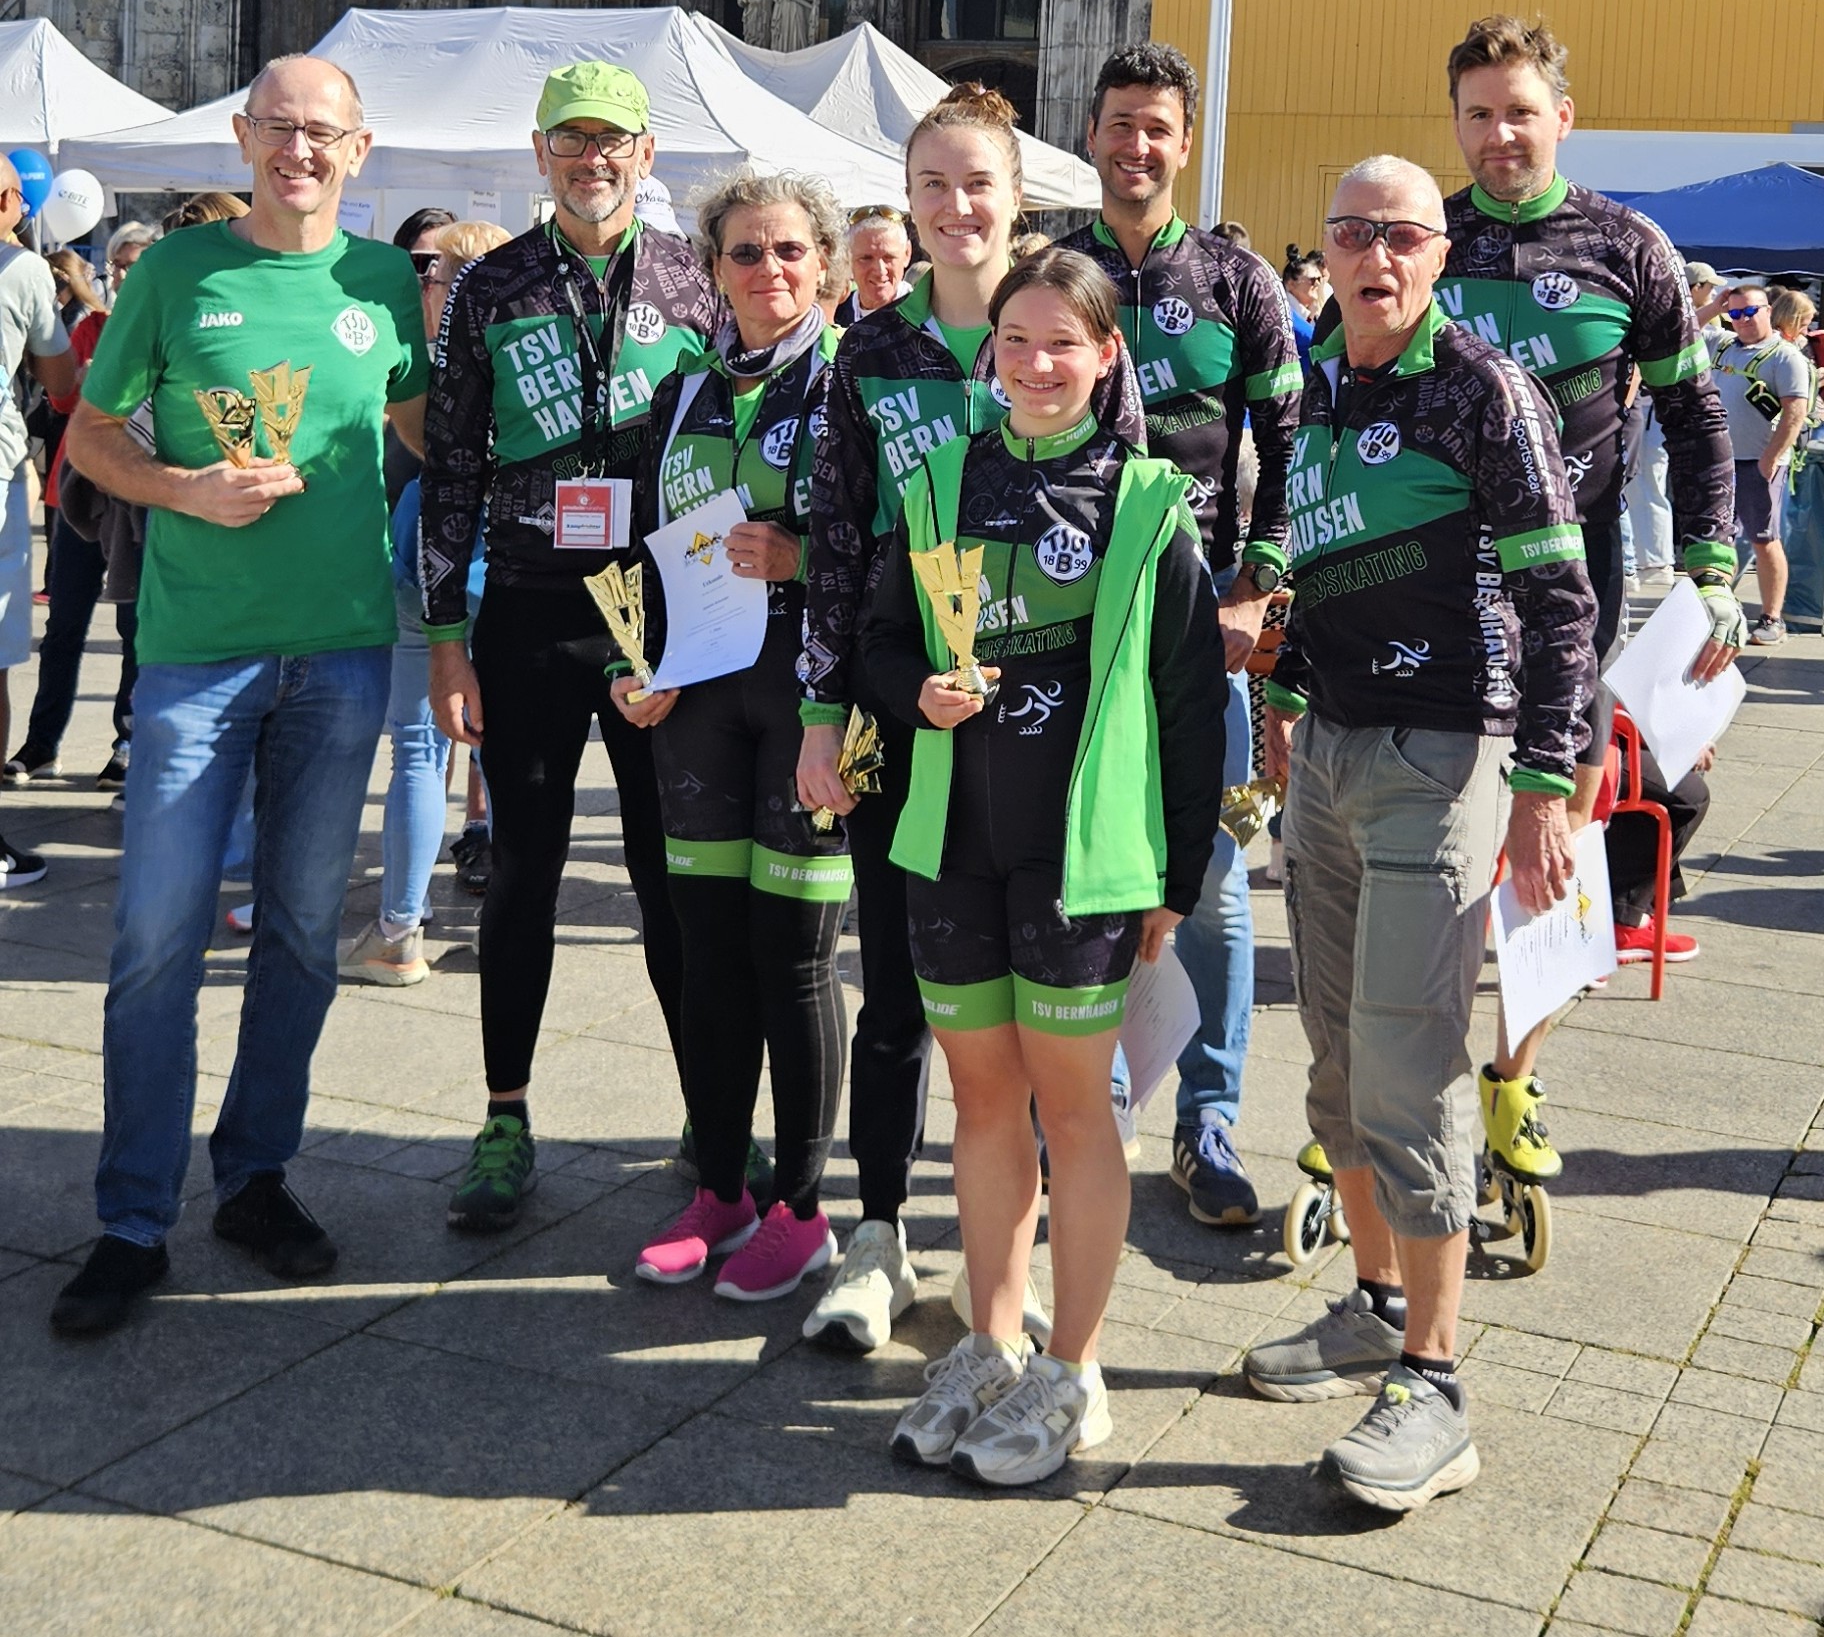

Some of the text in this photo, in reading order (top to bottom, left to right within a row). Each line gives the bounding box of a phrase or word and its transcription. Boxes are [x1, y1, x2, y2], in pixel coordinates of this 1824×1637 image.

[199, 312, 243, 329] JAKO
[503, 323, 562, 373] TSV
[868, 386, 921, 438] TSV
[664, 444, 694, 481] TSV
[884, 414, 958, 478] BERN
[665, 466, 716, 510] BERN
[1290, 492, 1367, 559] AUSEN
[1043, 552, 1088, 574] 18 B 99
[1521, 542, 1541, 560] TSV
[768, 862, 849, 882] TSV BERNHAUSEN
[1031, 998, 1118, 1020] TSV BERNHAUSEN
